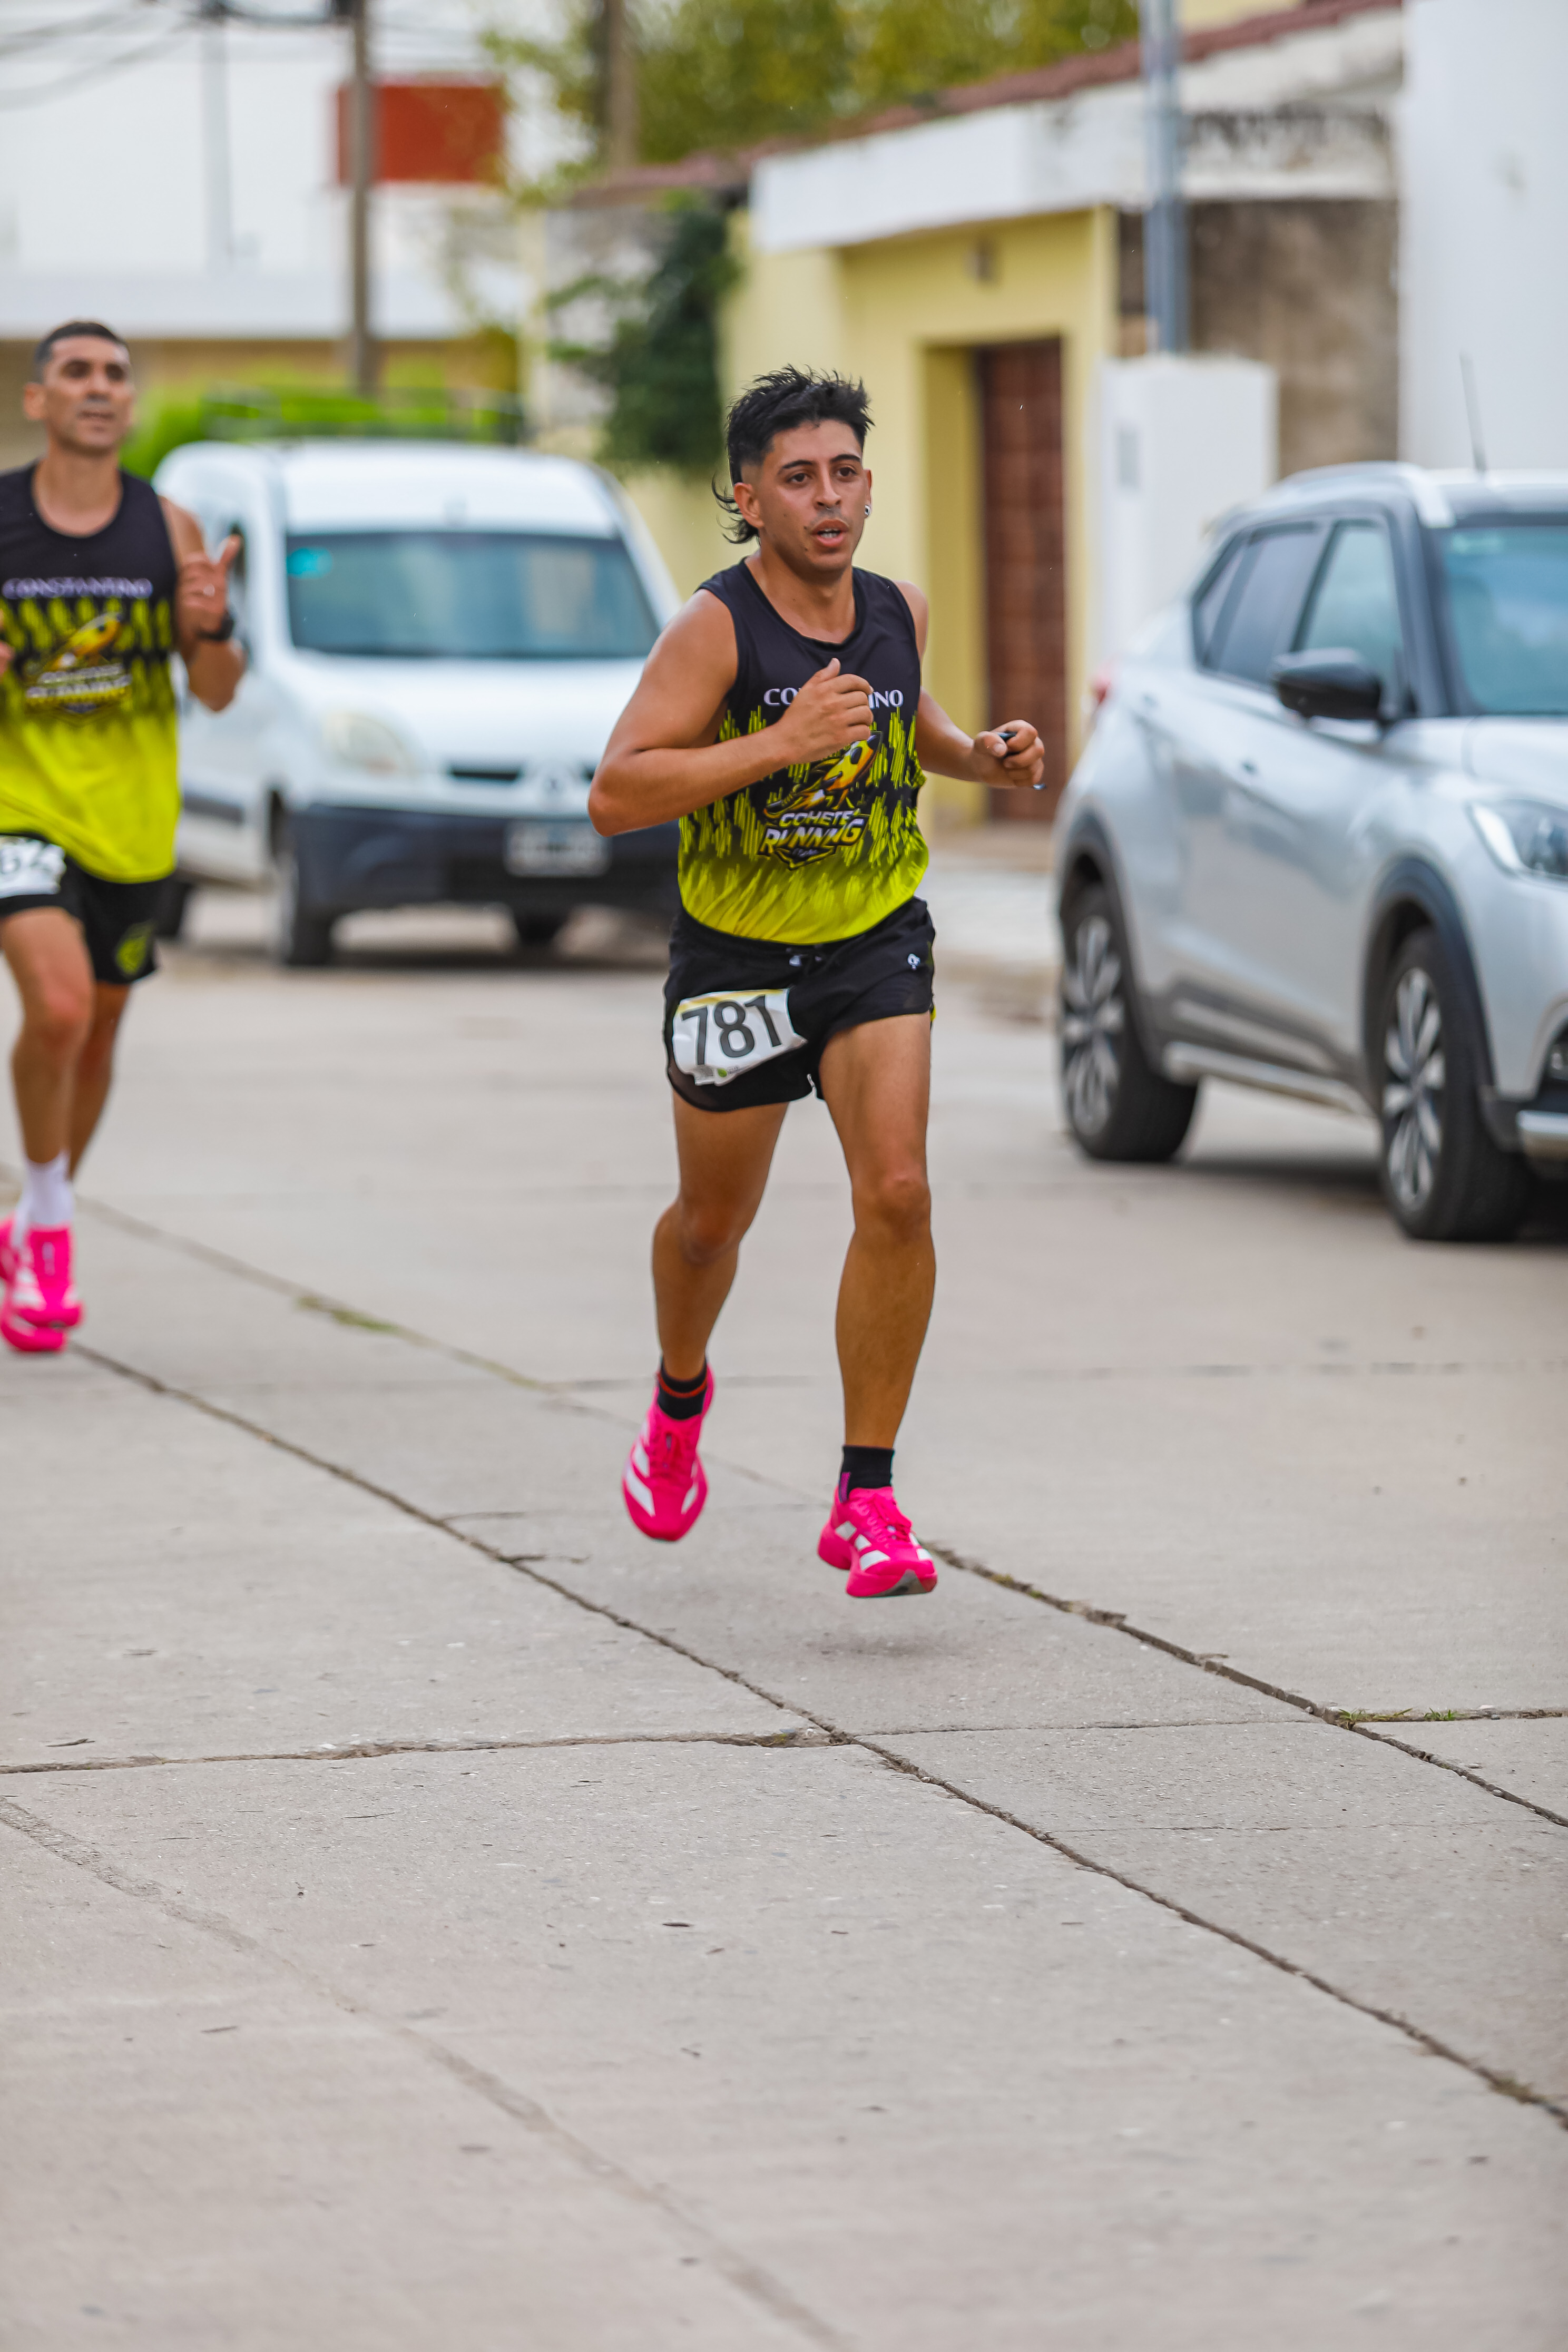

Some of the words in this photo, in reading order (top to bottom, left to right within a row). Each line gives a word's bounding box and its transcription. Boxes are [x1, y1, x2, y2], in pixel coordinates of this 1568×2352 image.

[760, 818, 865, 855] RUNNING
[779, 810, 855, 828] COHETE
[681, 994, 782, 1066] 781
